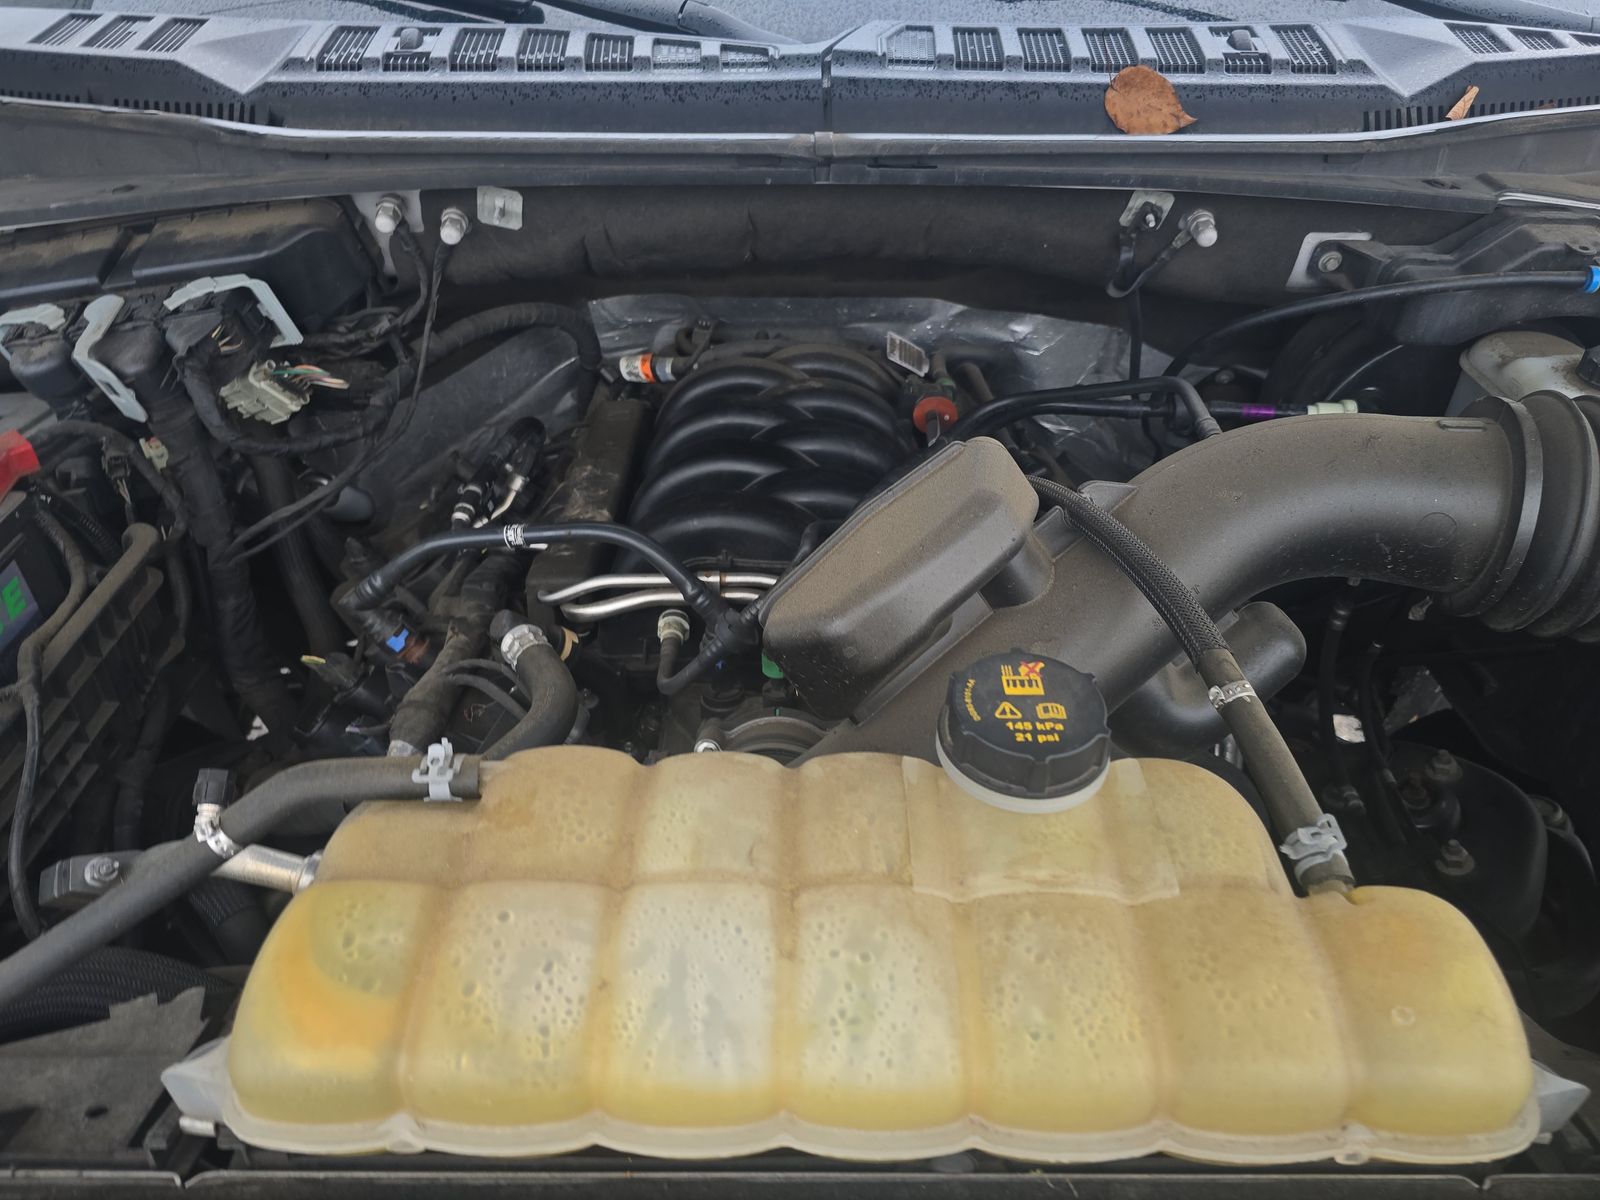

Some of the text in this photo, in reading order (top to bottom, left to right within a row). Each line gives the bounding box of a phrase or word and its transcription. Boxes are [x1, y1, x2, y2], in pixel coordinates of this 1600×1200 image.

[1006, 721, 1065, 731] 145 kPa
[1015, 732, 1060, 744] 21 psi
